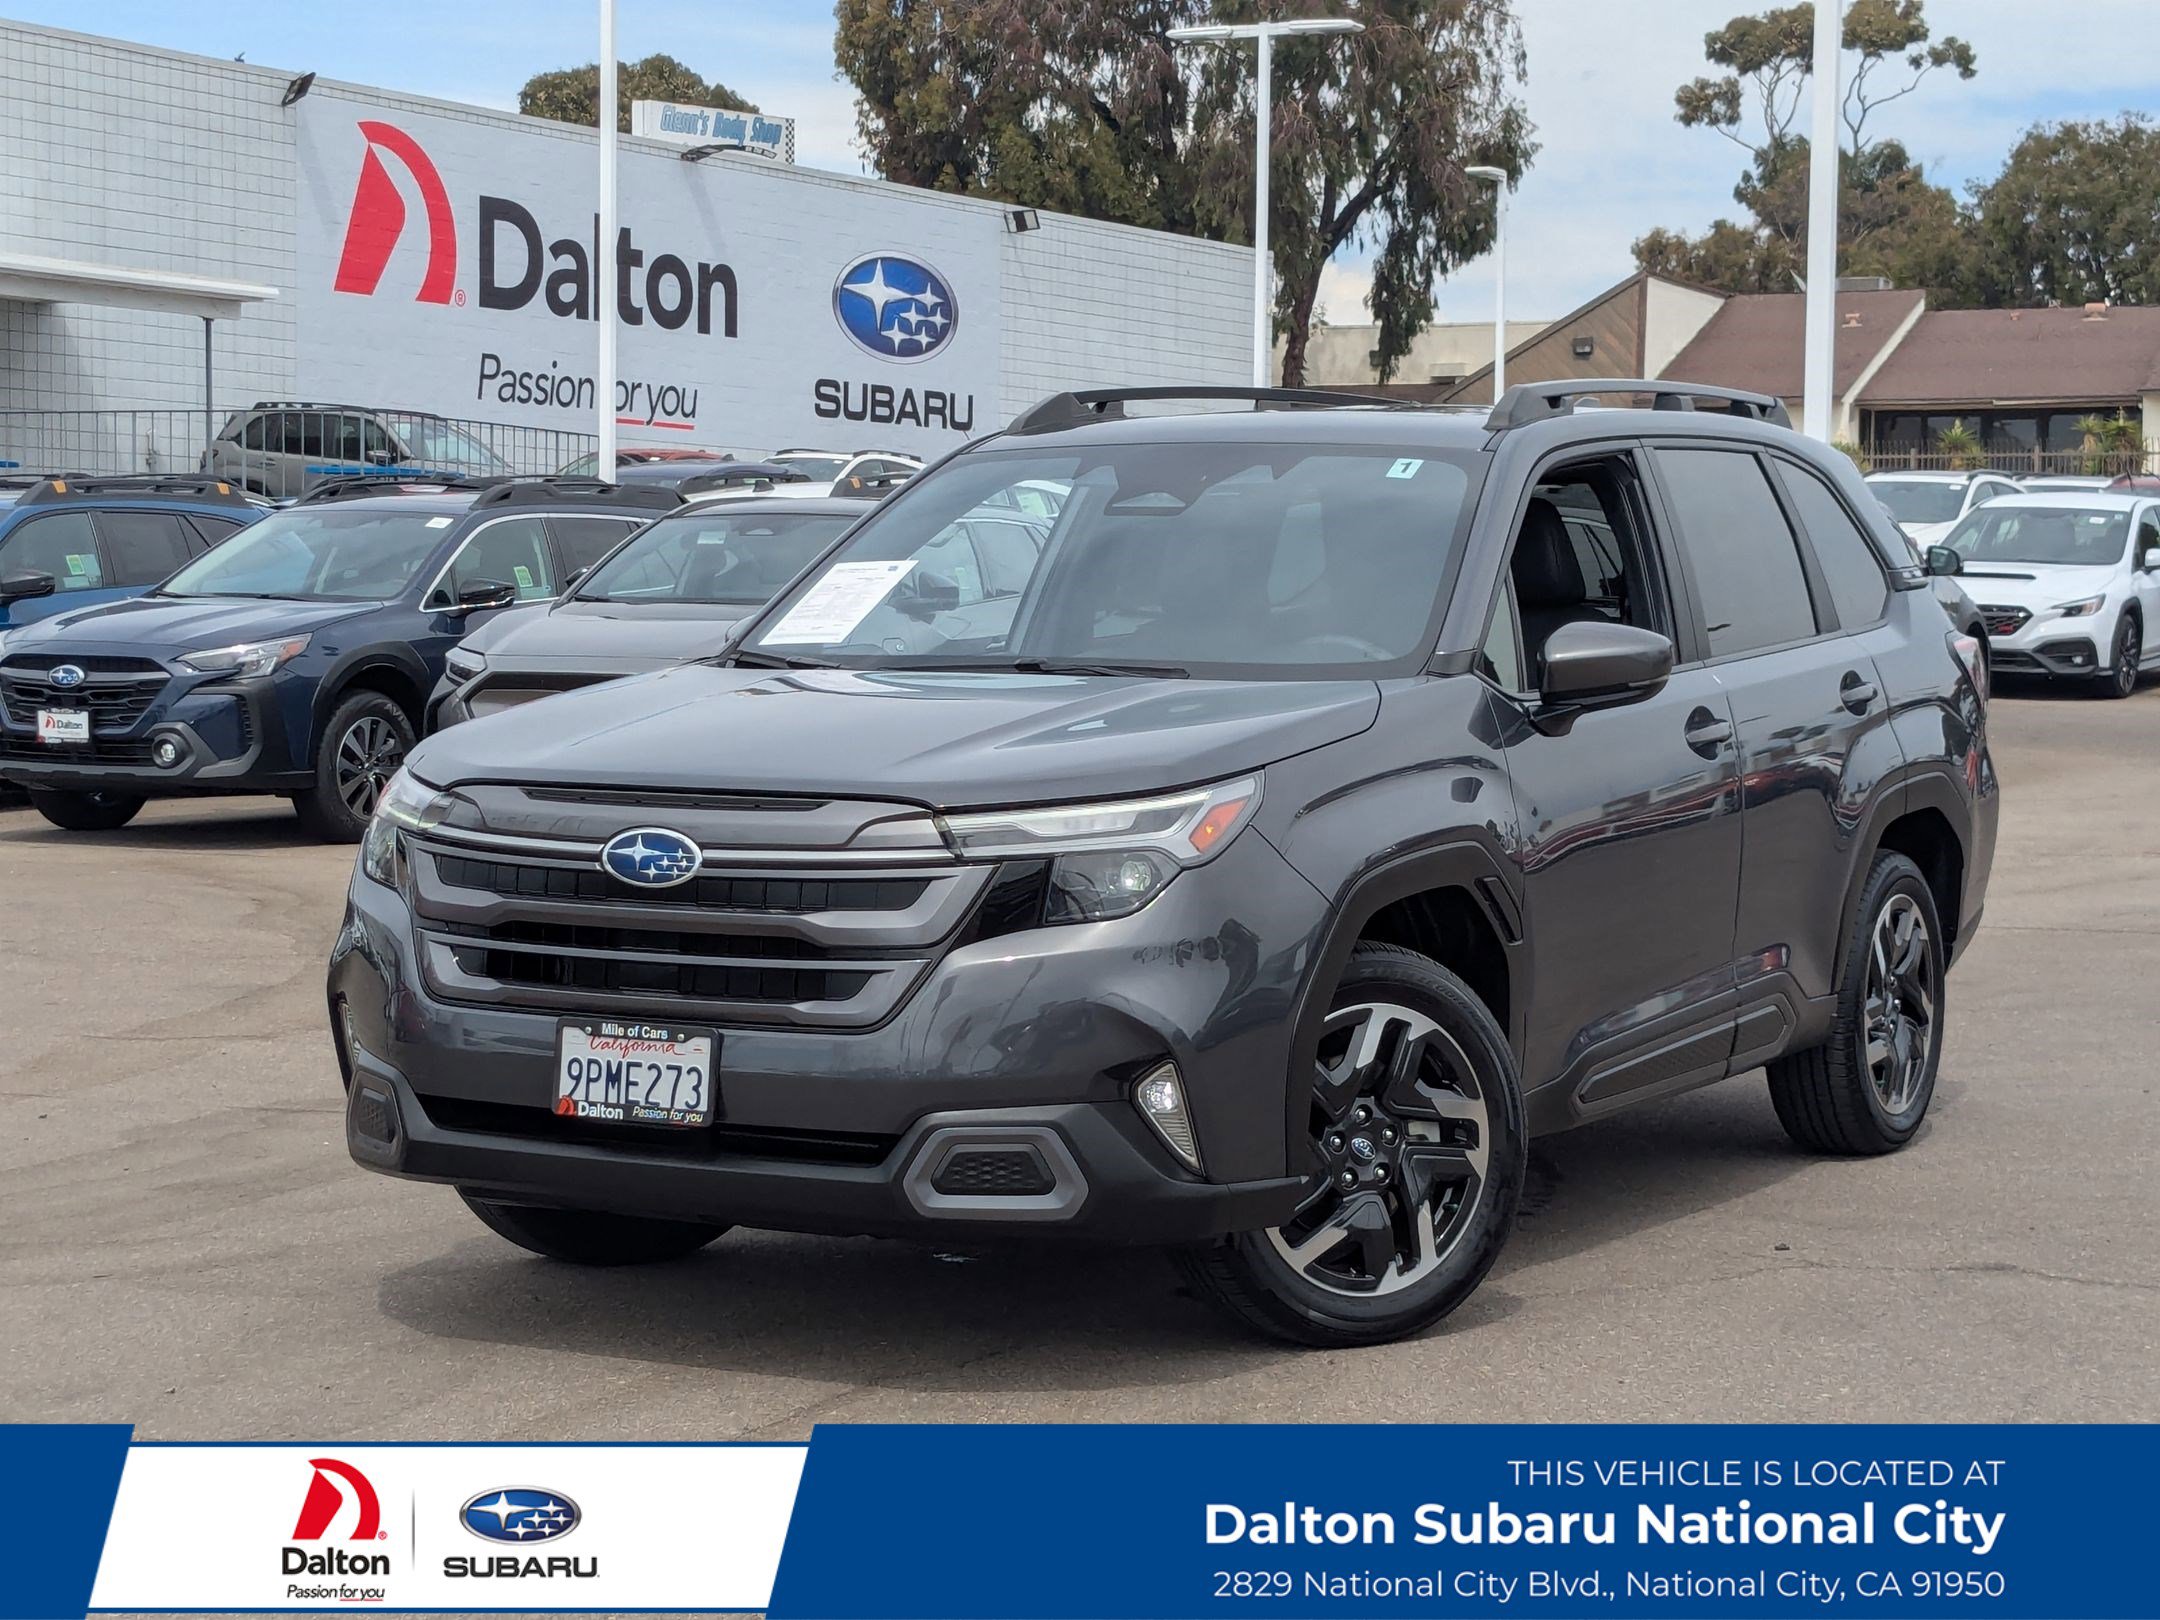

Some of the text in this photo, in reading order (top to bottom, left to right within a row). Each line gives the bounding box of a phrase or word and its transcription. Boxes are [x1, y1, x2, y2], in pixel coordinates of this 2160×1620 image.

[660, 105, 782, 149] Glenn's Body Shop
[477, 353, 698, 426] Passion or you
[814, 378, 974, 432] SUBARU
[1400, 461, 1413, 474] 1
[601, 1023, 668, 1040] Mile of Cars
[589, 1036, 685, 1059] California
[567, 1057, 703, 1110] 9PME273
[578, 1101, 624, 1120] Dalton
[632, 1105, 704, 1124] Passion for you
